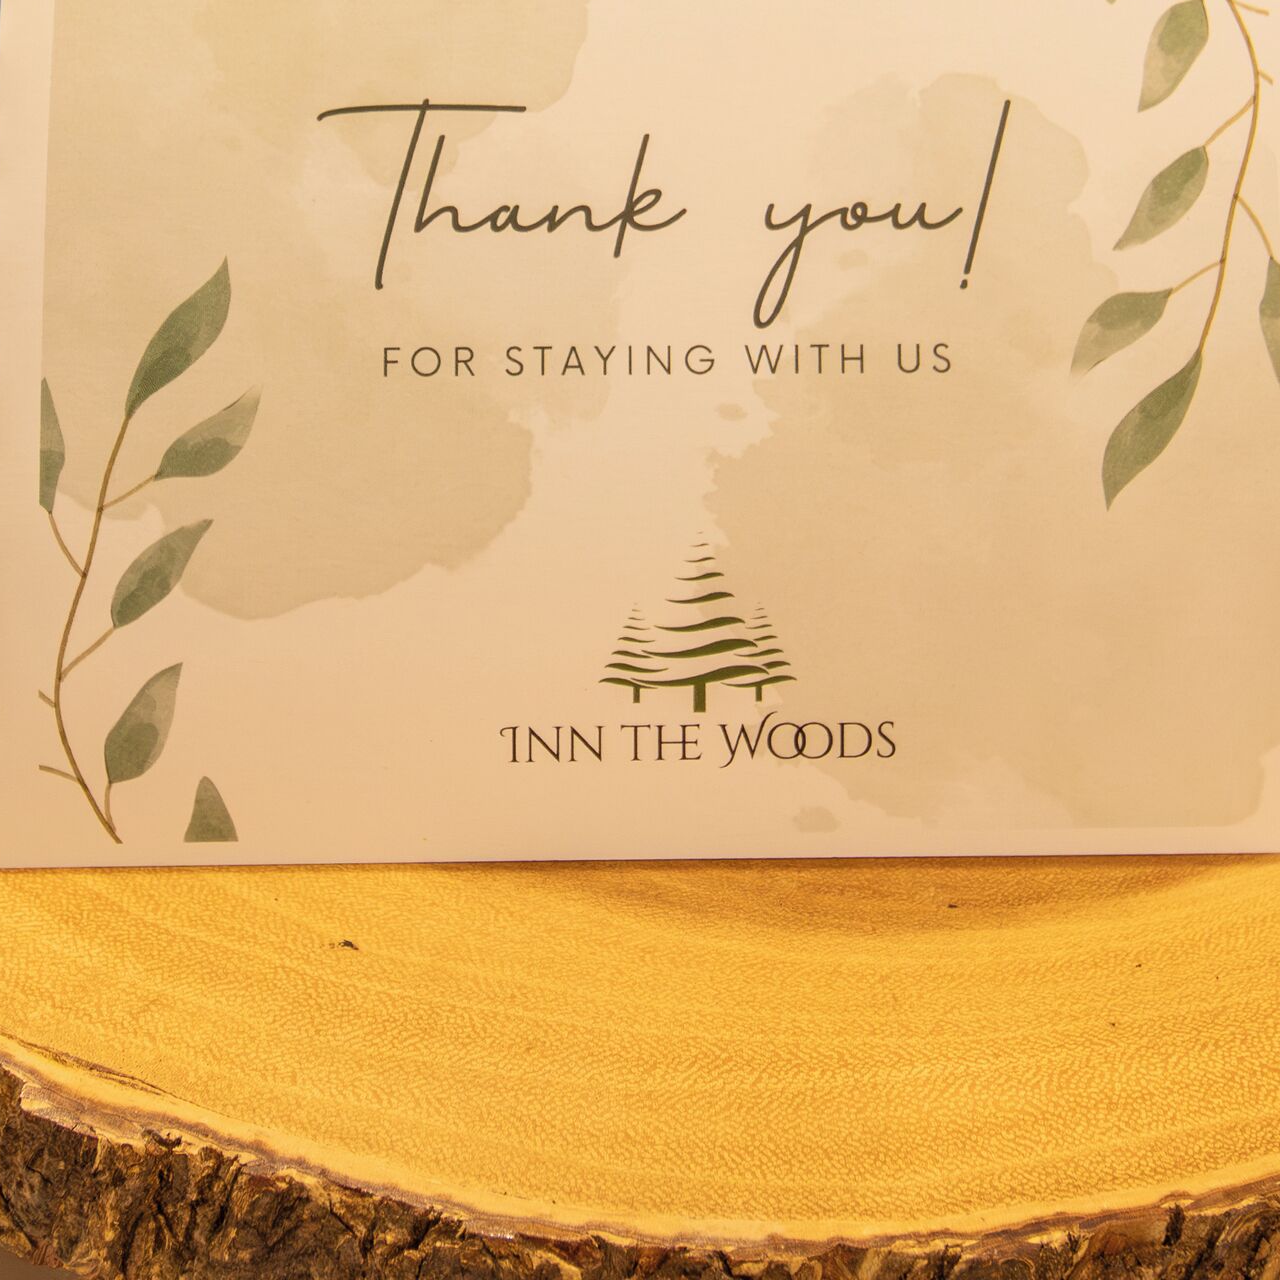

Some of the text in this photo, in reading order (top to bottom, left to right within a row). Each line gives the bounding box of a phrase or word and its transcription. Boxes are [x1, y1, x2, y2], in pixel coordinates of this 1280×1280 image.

[317, 98, 1010, 328] Thank you!
[382, 340, 954, 378] FOR STAYING WITH US
[500, 709, 898, 771] INN THE WOODS
